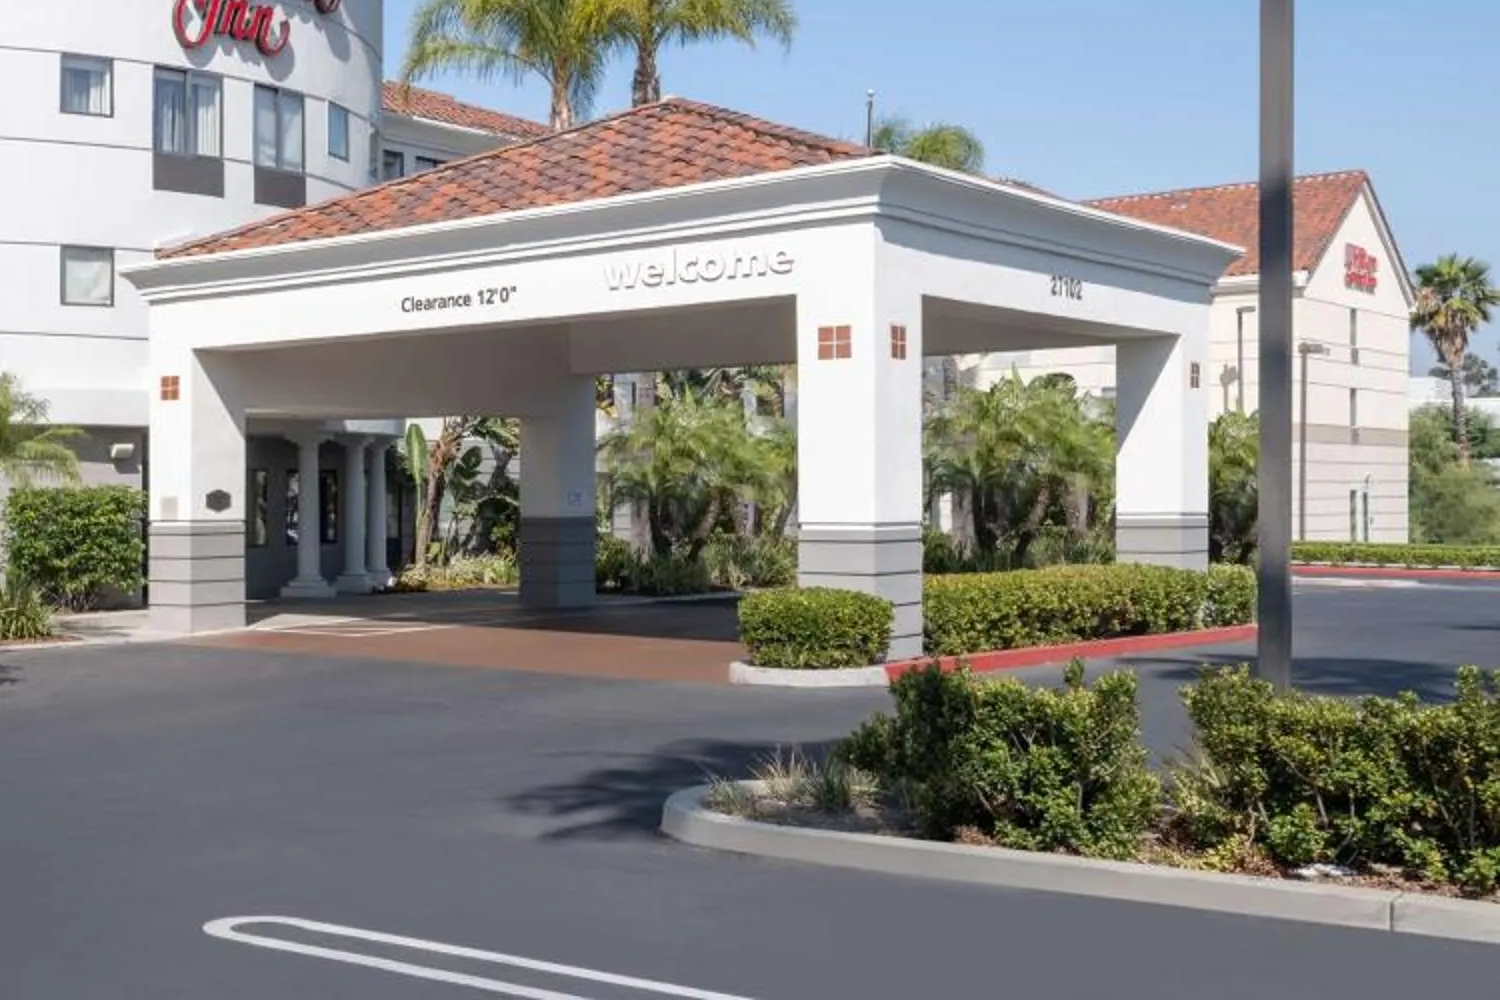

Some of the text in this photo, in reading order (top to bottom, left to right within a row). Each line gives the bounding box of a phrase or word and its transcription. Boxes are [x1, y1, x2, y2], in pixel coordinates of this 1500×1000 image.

[605, 247, 794, 291] welcome
[1050, 274, 1083, 300] 27102
[401, 294, 472, 312] Clearance
